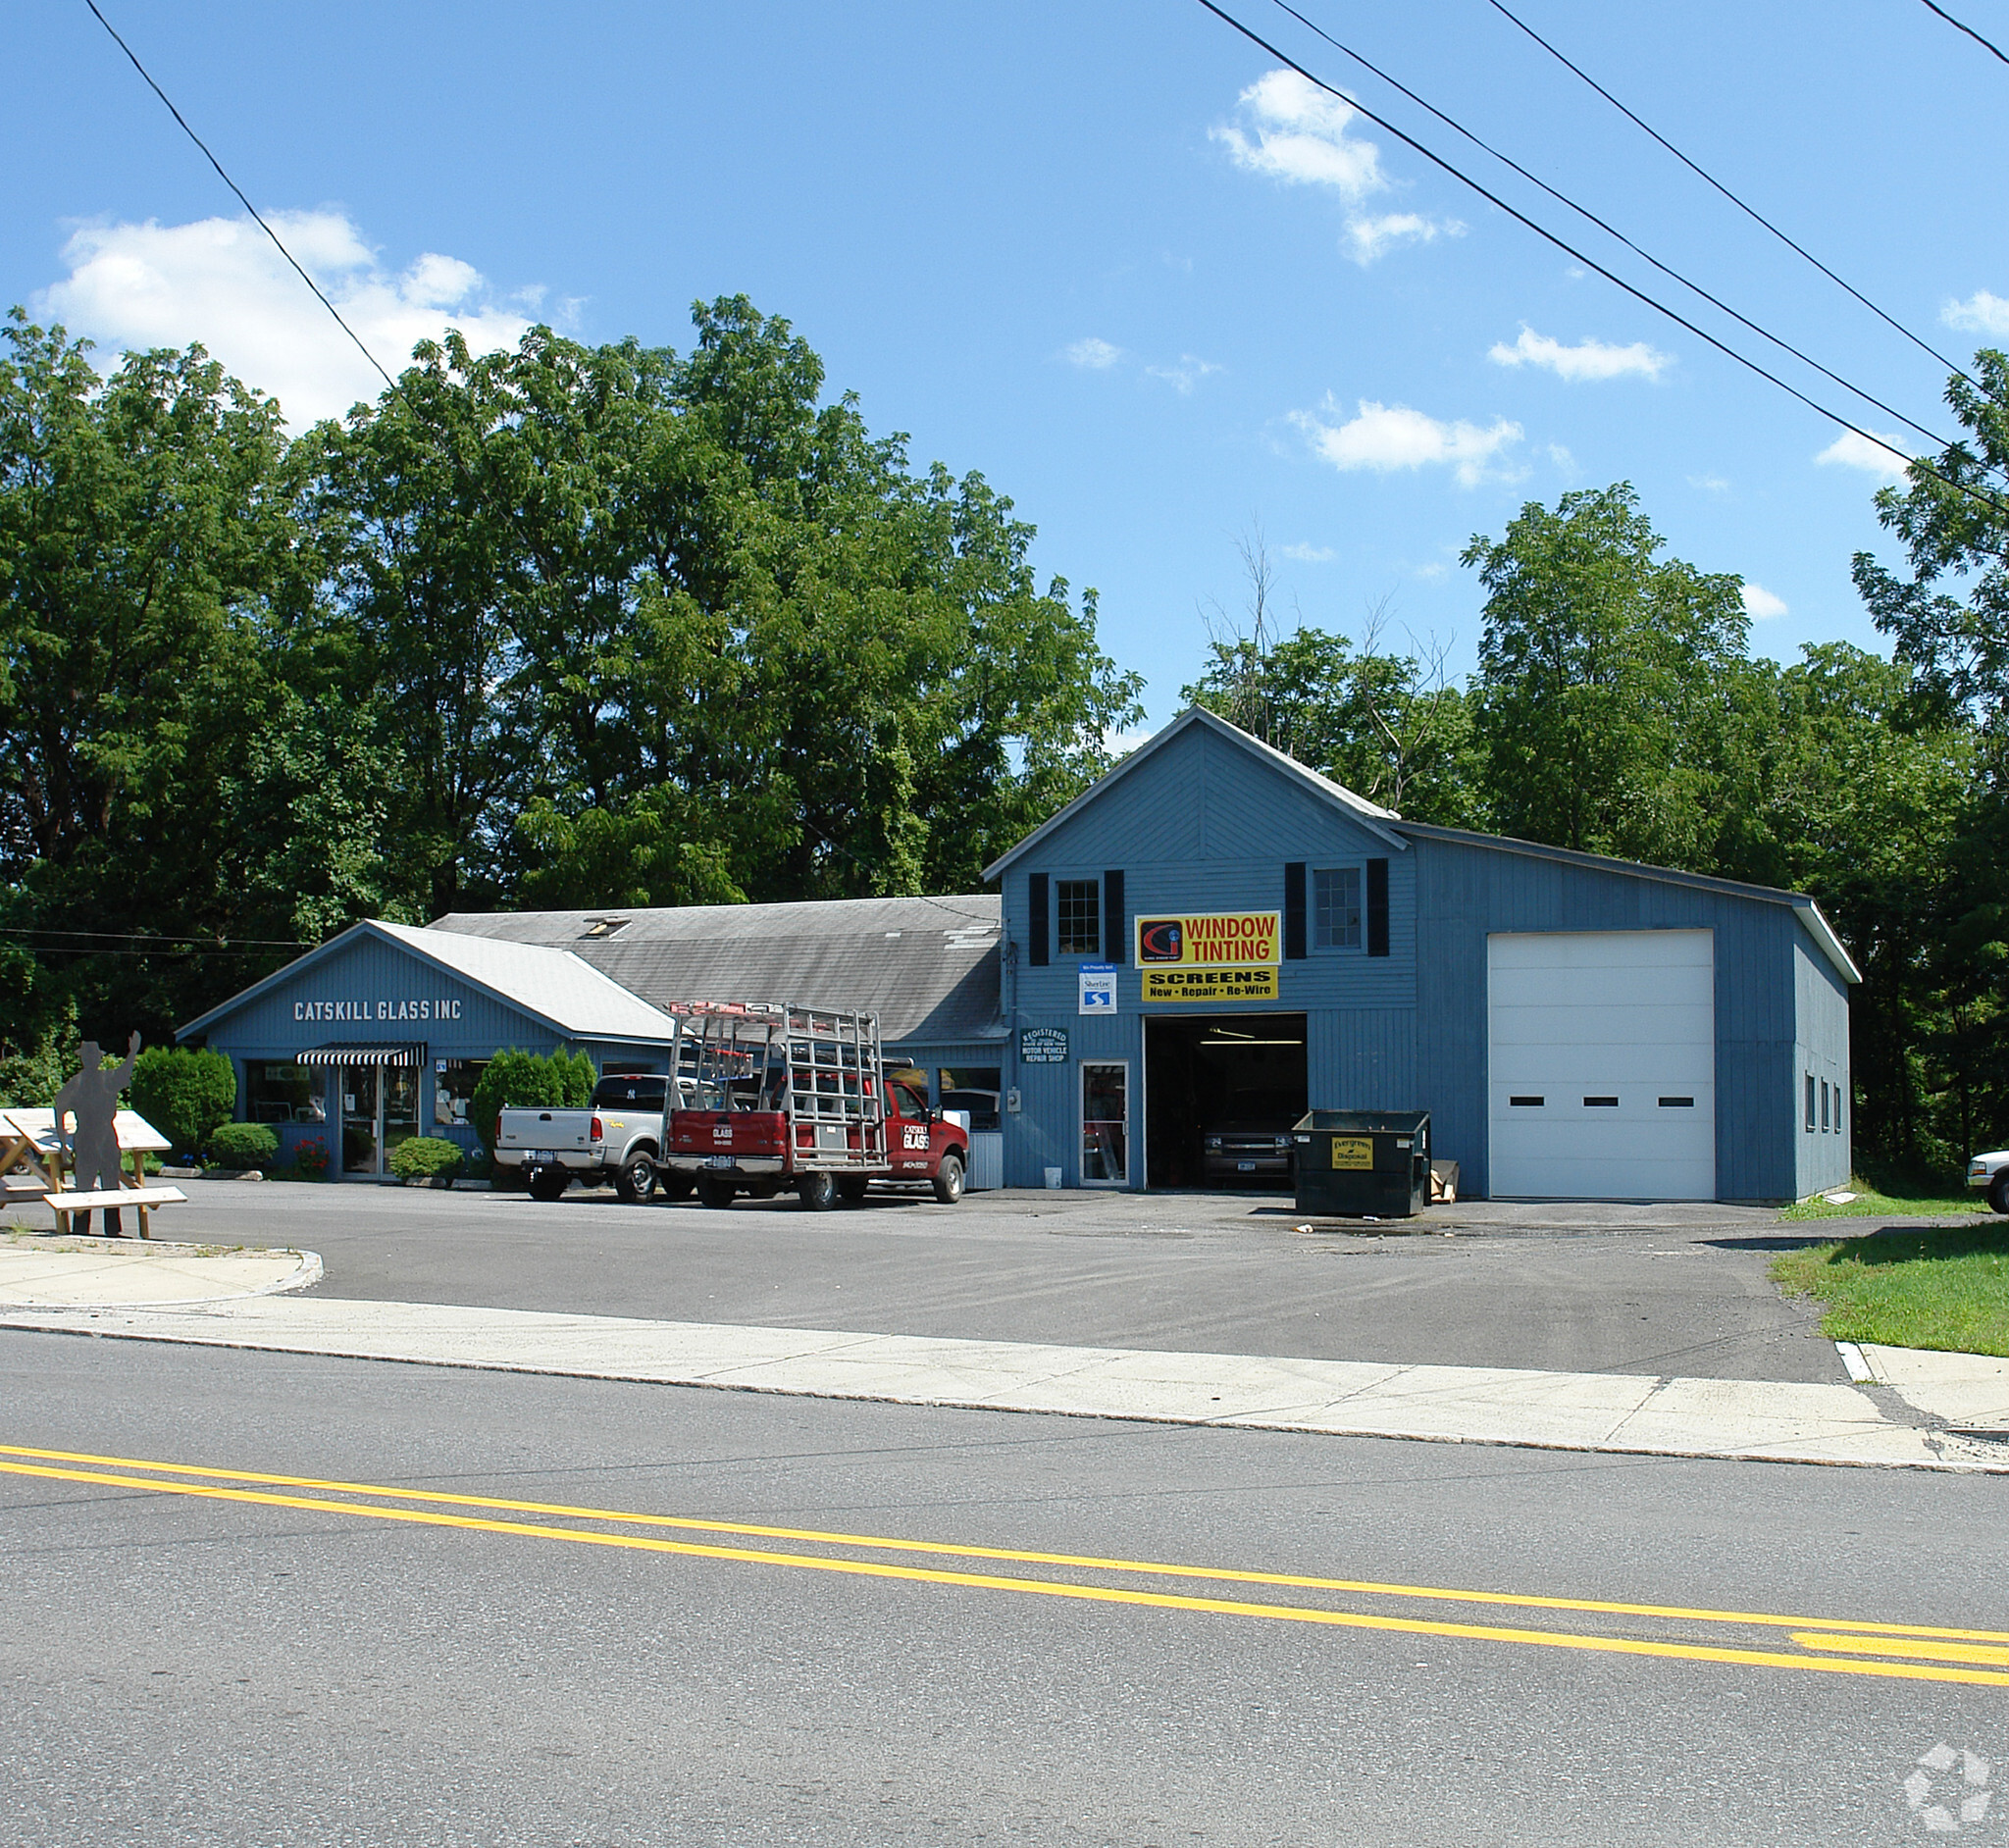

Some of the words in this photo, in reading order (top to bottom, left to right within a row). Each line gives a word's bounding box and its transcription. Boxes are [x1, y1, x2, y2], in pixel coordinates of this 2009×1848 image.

[1185, 916, 1275, 939] WINDOW
[1192, 940, 1269, 961] TINTING
[1149, 971, 1271, 985] SCREENS
[1150, 987, 1172, 997] New
[1182, 986, 1216, 997] Repair
[1227, 985, 1271, 996] Re-Wire
[295, 1001, 373, 1021] CATSKILL
[378, 1001, 431, 1020] GLASS
[435, 1000, 462, 1019] INC
[1022, 1028, 1066, 1042] REGISTERED
[903, 1134, 930, 1150] GLASS
